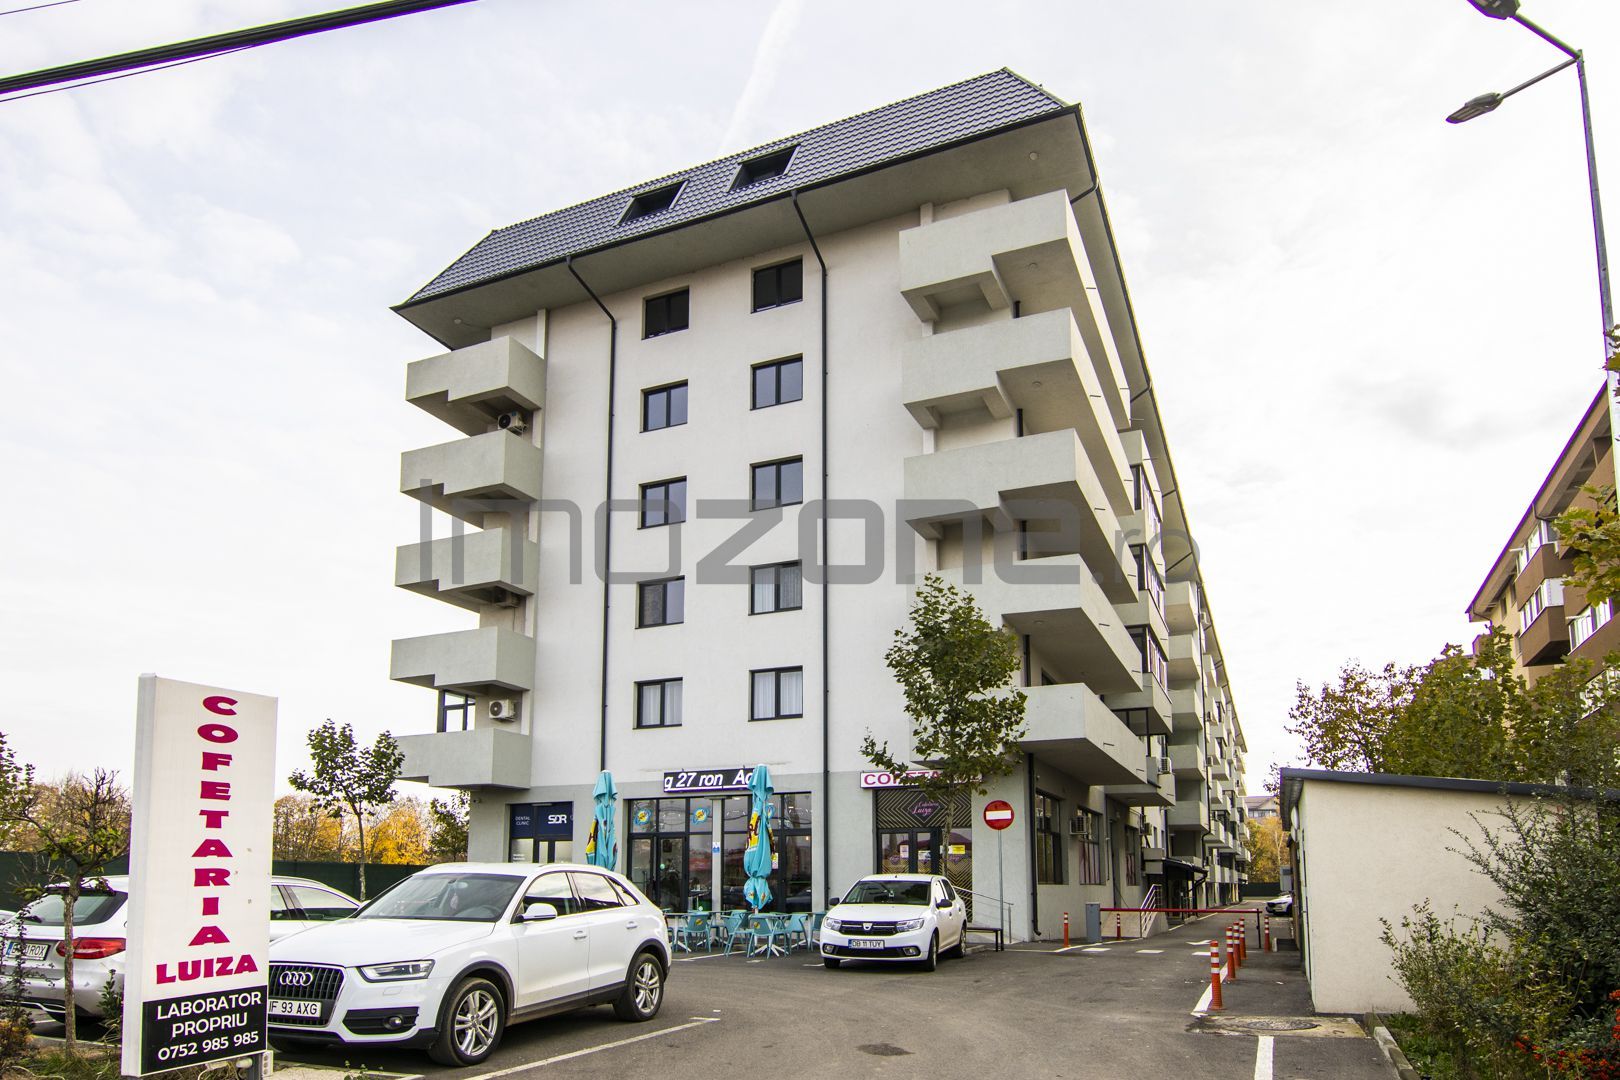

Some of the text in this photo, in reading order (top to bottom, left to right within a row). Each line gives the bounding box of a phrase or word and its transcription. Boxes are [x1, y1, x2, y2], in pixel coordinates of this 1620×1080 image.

[676, 772, 697, 788] 27
[699, 773, 723, 787] ron
[188, 695, 239, 947] COFETARIA
[156, 954, 259, 984] LUIZA
[156, 991, 262, 1020] LABORATOR
[281, 1002, 293, 1013] 93
[296, 1002, 318, 1015] AXG
[171, 1012, 248, 1039] PROPRIU
[157, 1031, 259, 1061] 0752 985 985
